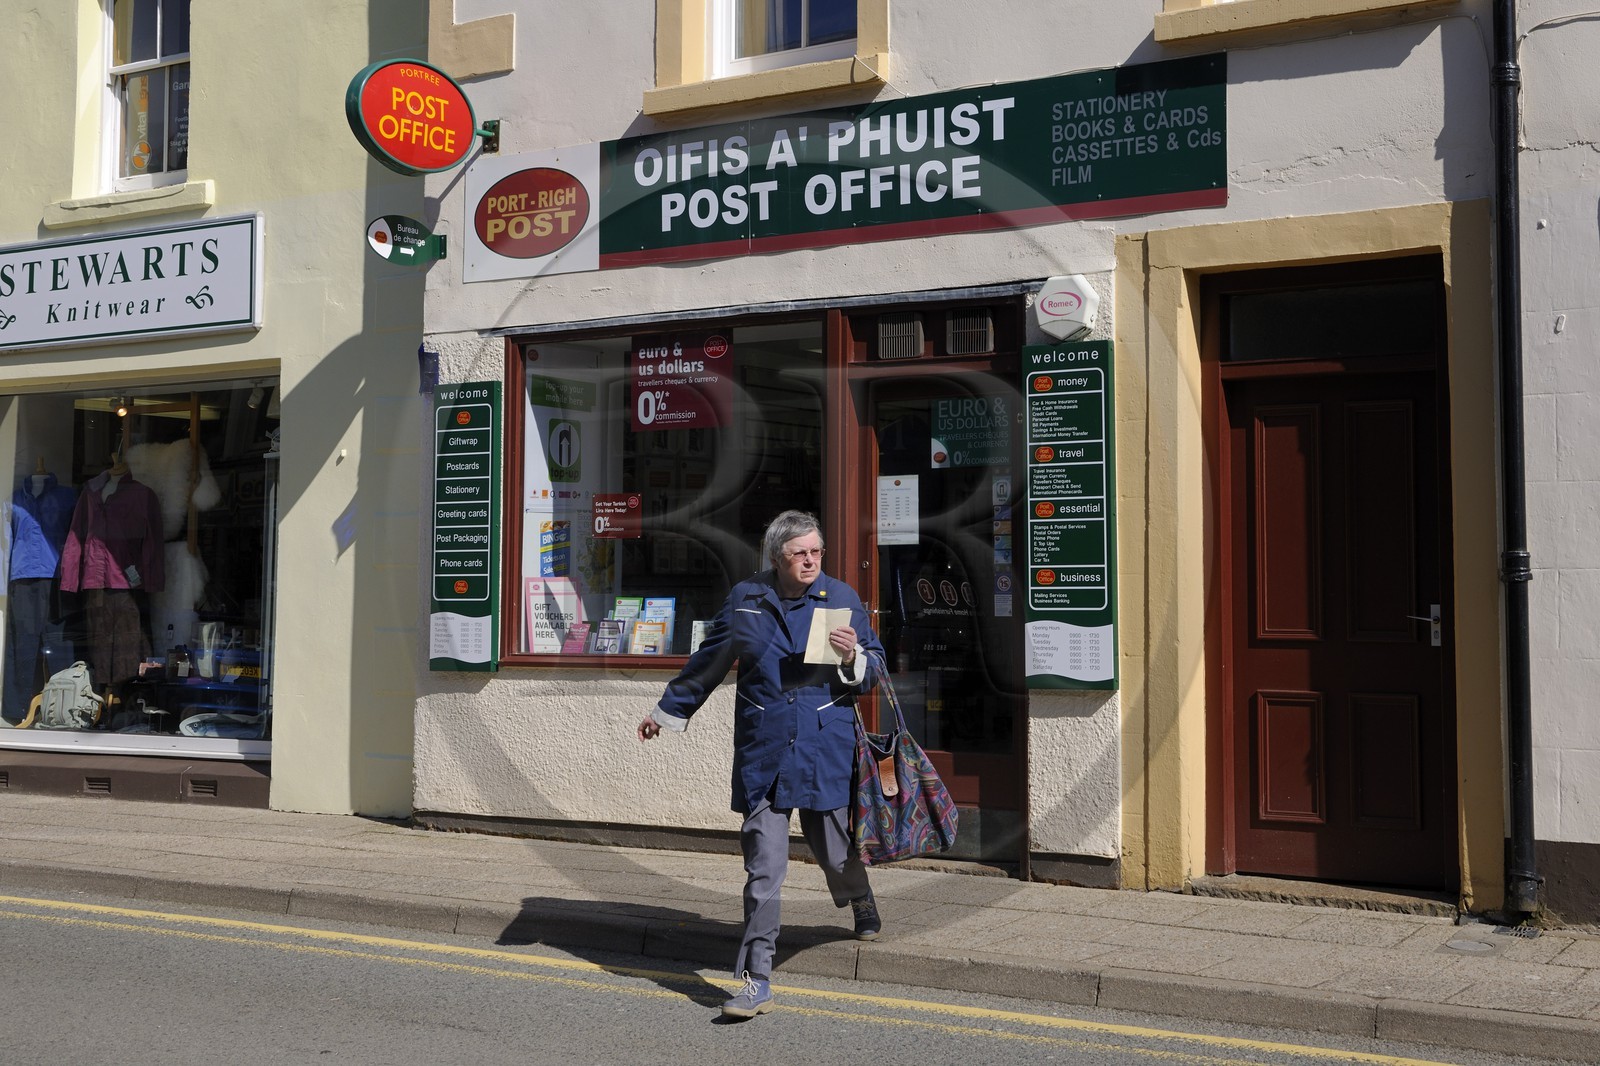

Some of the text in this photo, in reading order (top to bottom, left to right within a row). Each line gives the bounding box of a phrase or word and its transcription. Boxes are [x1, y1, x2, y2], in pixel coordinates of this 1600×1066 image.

[400, 69, 440, 86] PORTREE
[392, 87, 449, 121] POST
[1052, 89, 1168, 121] STATIONERY
[1052, 106, 1208, 143] BOOKS & CARDS
[379, 114, 455, 153] OFFICE
[634, 97, 1015, 187] OIFIS A' PHUIST
[1052, 128, 1222, 164] CASSETTES & Cds
[1052, 165, 1092, 186] FILM
[661, 155, 982, 233] POST OFFICE
[397, 224, 419, 235] Bureau
[486, 210, 576, 242] POST
[394, 234, 402, 242] de
[403, 234, 425, 247] change
[0, 238, 219, 297] STEWARTS
[46, 296, 165, 324] Knitwear
[1048, 300, 1073, 308] Romec
[638, 342, 682, 360] euro &
[1032, 350, 1099, 364] welcome
[638, 360, 704, 376] us dollars
[638, 379, 664, 387] travellers
[664, 378, 687, 387] cheques
[694, 376, 718, 384] currency
[1058, 378, 1088, 387] money
[440, 388, 488, 400] welcome
[938, 397, 1006, 418] EURO &
[655, 410, 696, 420] commission
[938, 415, 1008, 430] US DOLLARS
[449, 437, 478, 447] Giftwrap
[1059, 448, 1084, 458] travel
[446, 462, 479, 471] Postcards
[550, 466, 580, 480] top-up
[445, 485, 480, 495] Stationery
[438, 509, 487, 520] Greeting cards
[1060, 503, 1100, 513] essential
[453, 534, 488, 543] Packaging
[464, 559, 483, 567] cards
[1060, 573, 1100, 582] business
[535, 613, 574, 621] VOUCHERS
